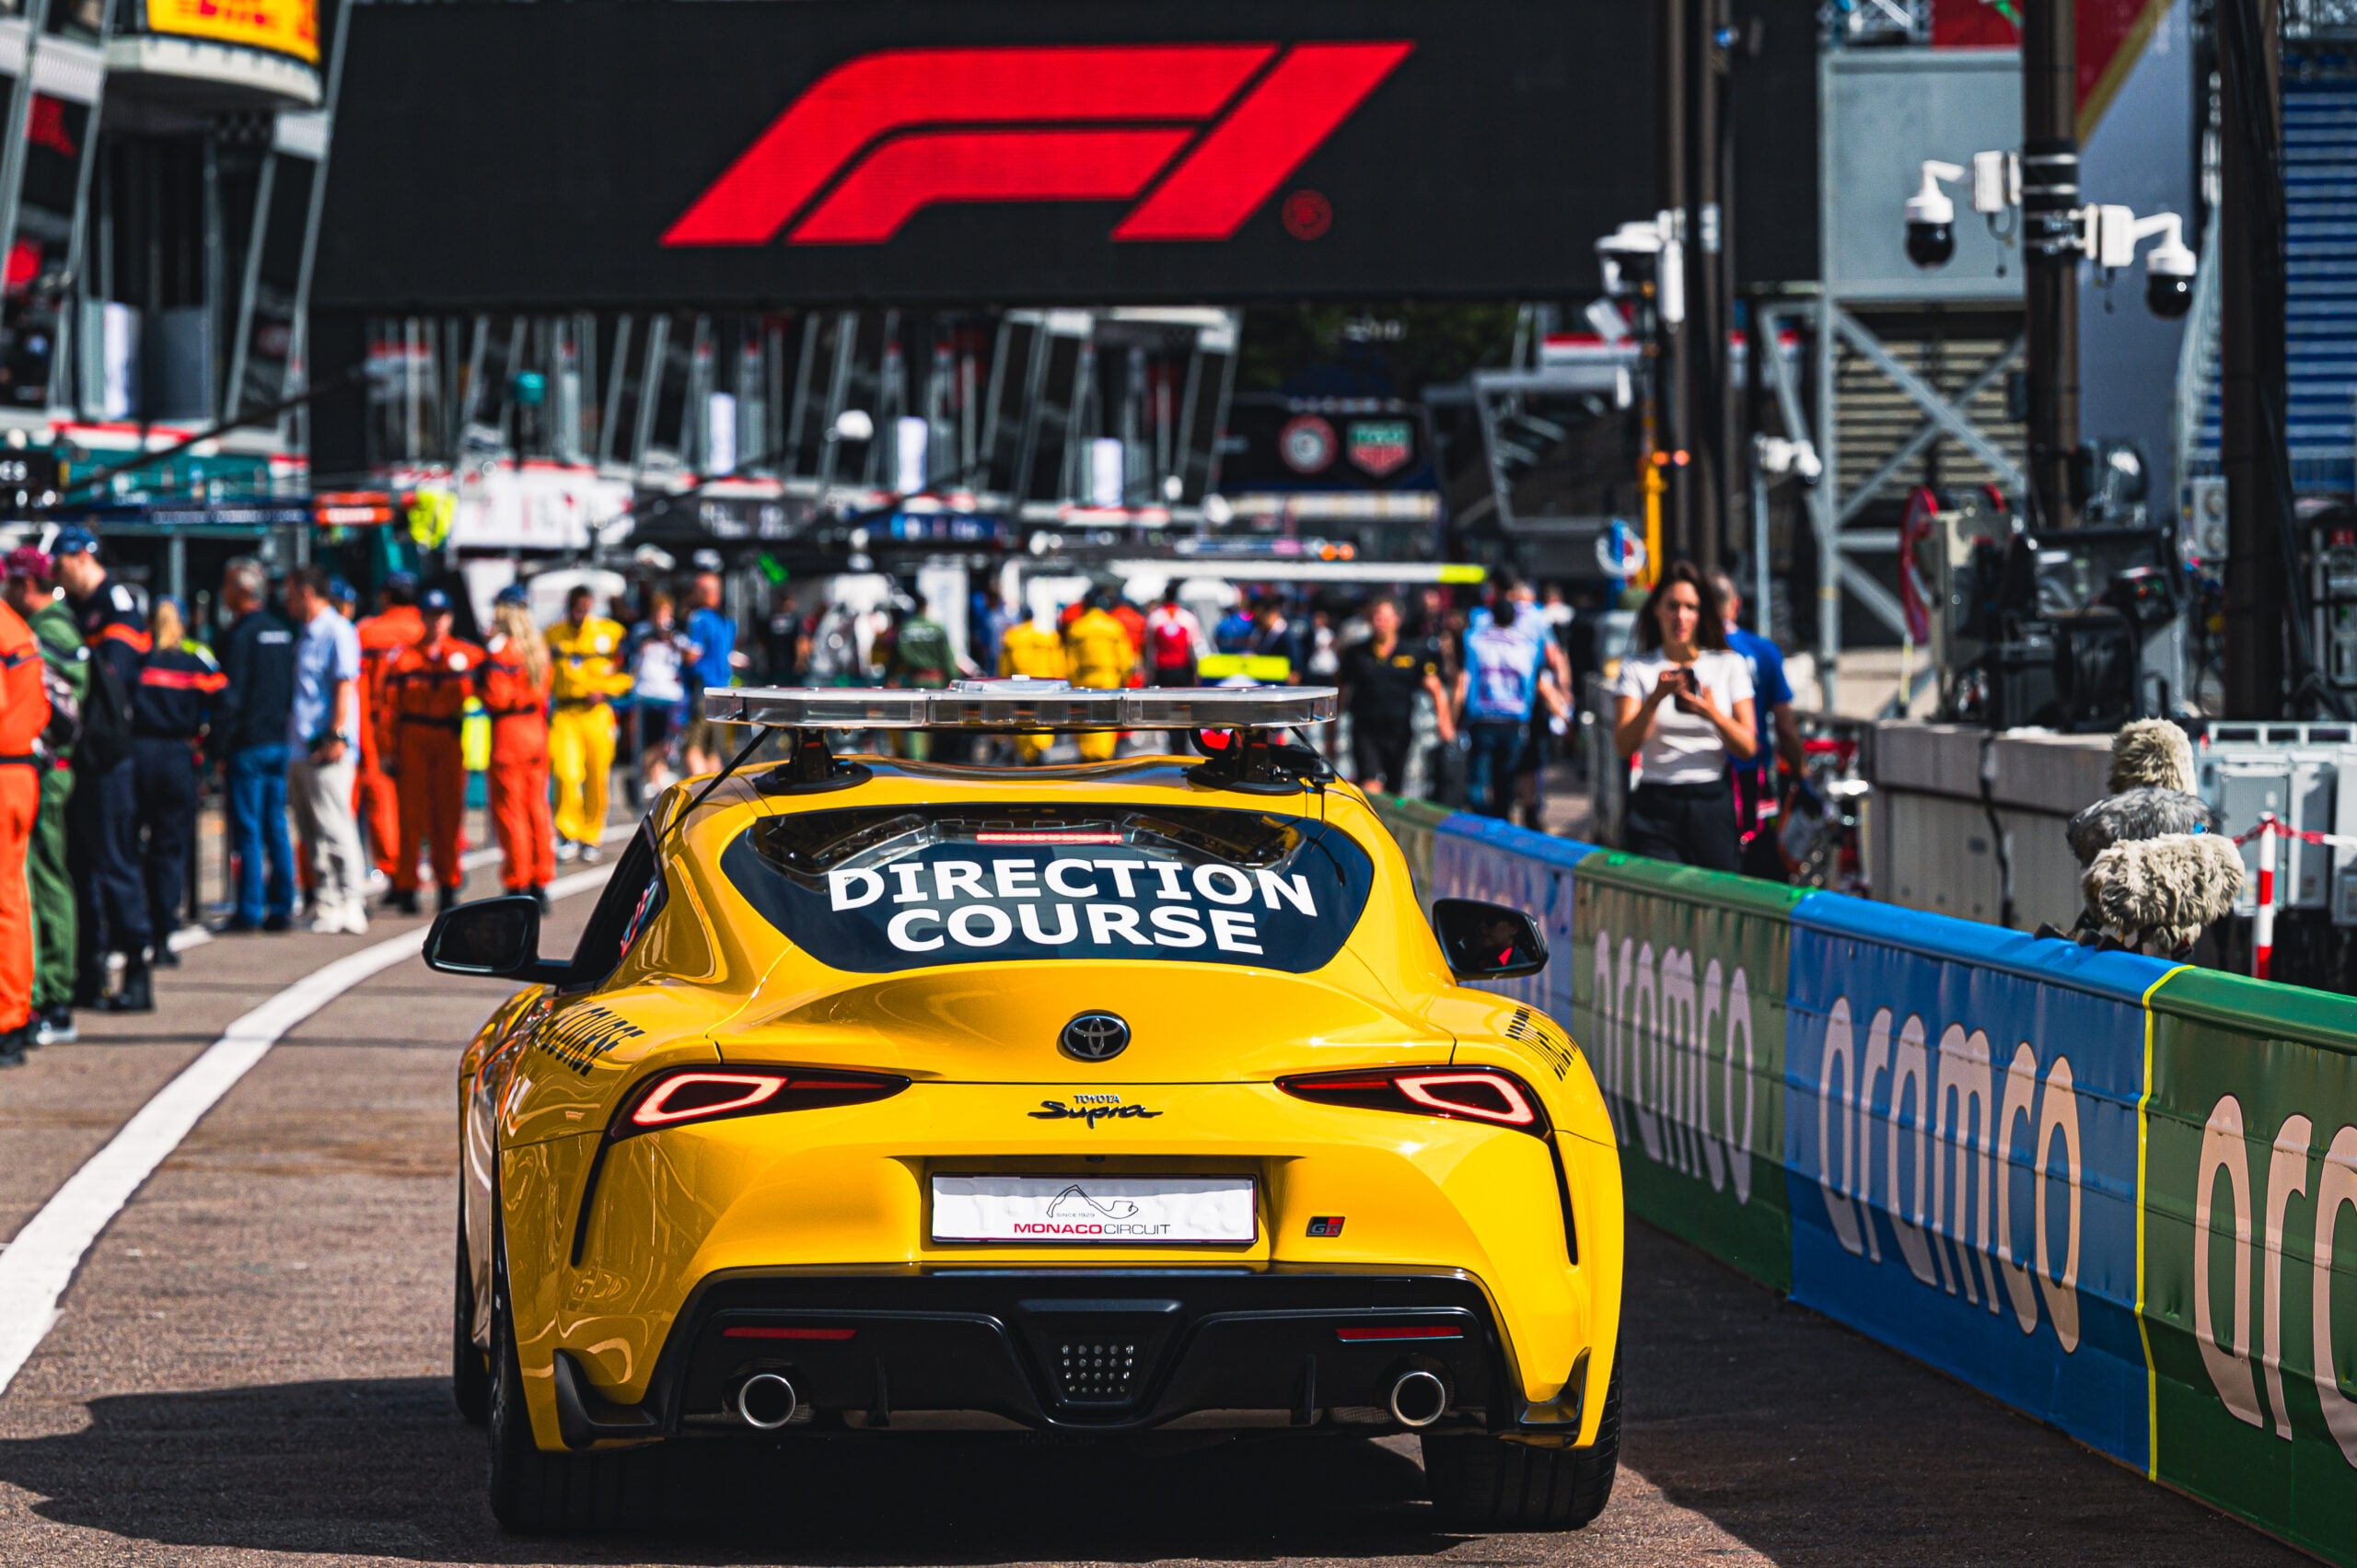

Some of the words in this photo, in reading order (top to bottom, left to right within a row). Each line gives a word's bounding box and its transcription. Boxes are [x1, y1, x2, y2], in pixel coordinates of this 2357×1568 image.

[829, 858, 1318, 917] DIRECTION
[887, 903, 1264, 955] COURSE
[1592, 929, 1754, 1205] aramco
[1027, 1100, 1164, 1130] Supra
[1073, 1093, 1121, 1104] TOYOTA
[1818, 994, 2082, 1354] aramco
